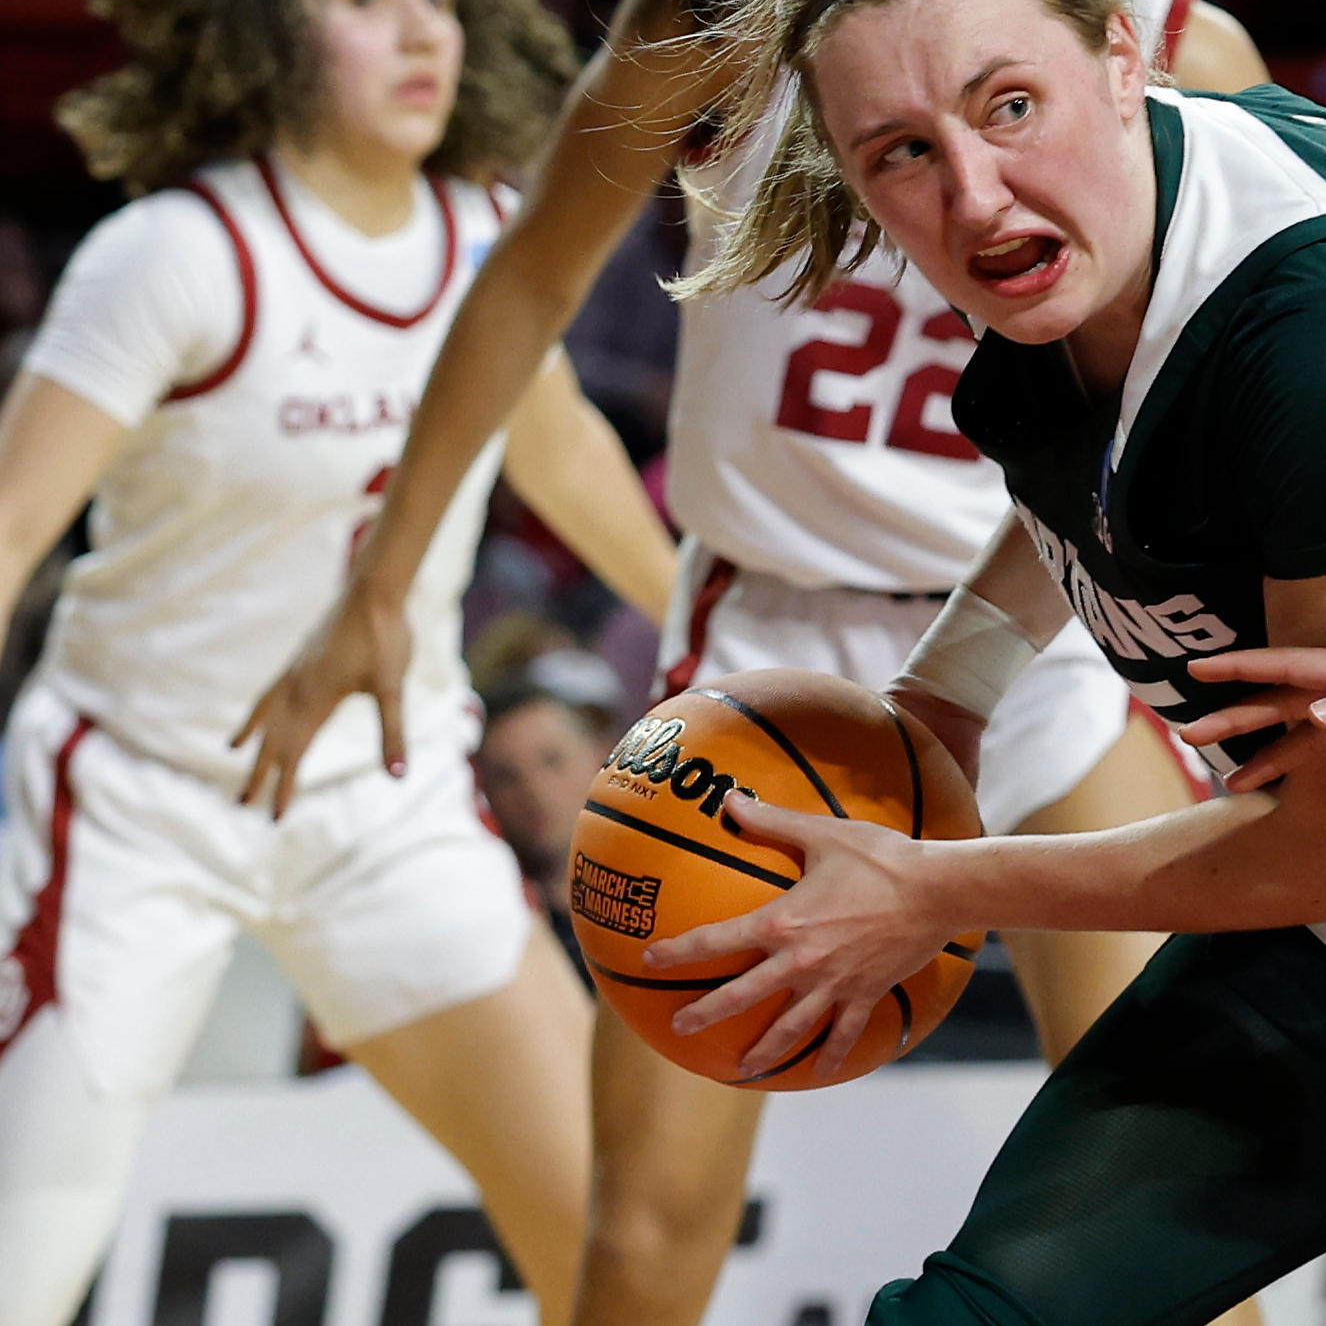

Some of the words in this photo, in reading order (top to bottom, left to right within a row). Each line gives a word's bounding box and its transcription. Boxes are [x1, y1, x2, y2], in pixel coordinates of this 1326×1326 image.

[775, 278, 986, 461] 22
[582, 860, 628, 901] MARCH
[584, 886, 654, 932] MADNESS
